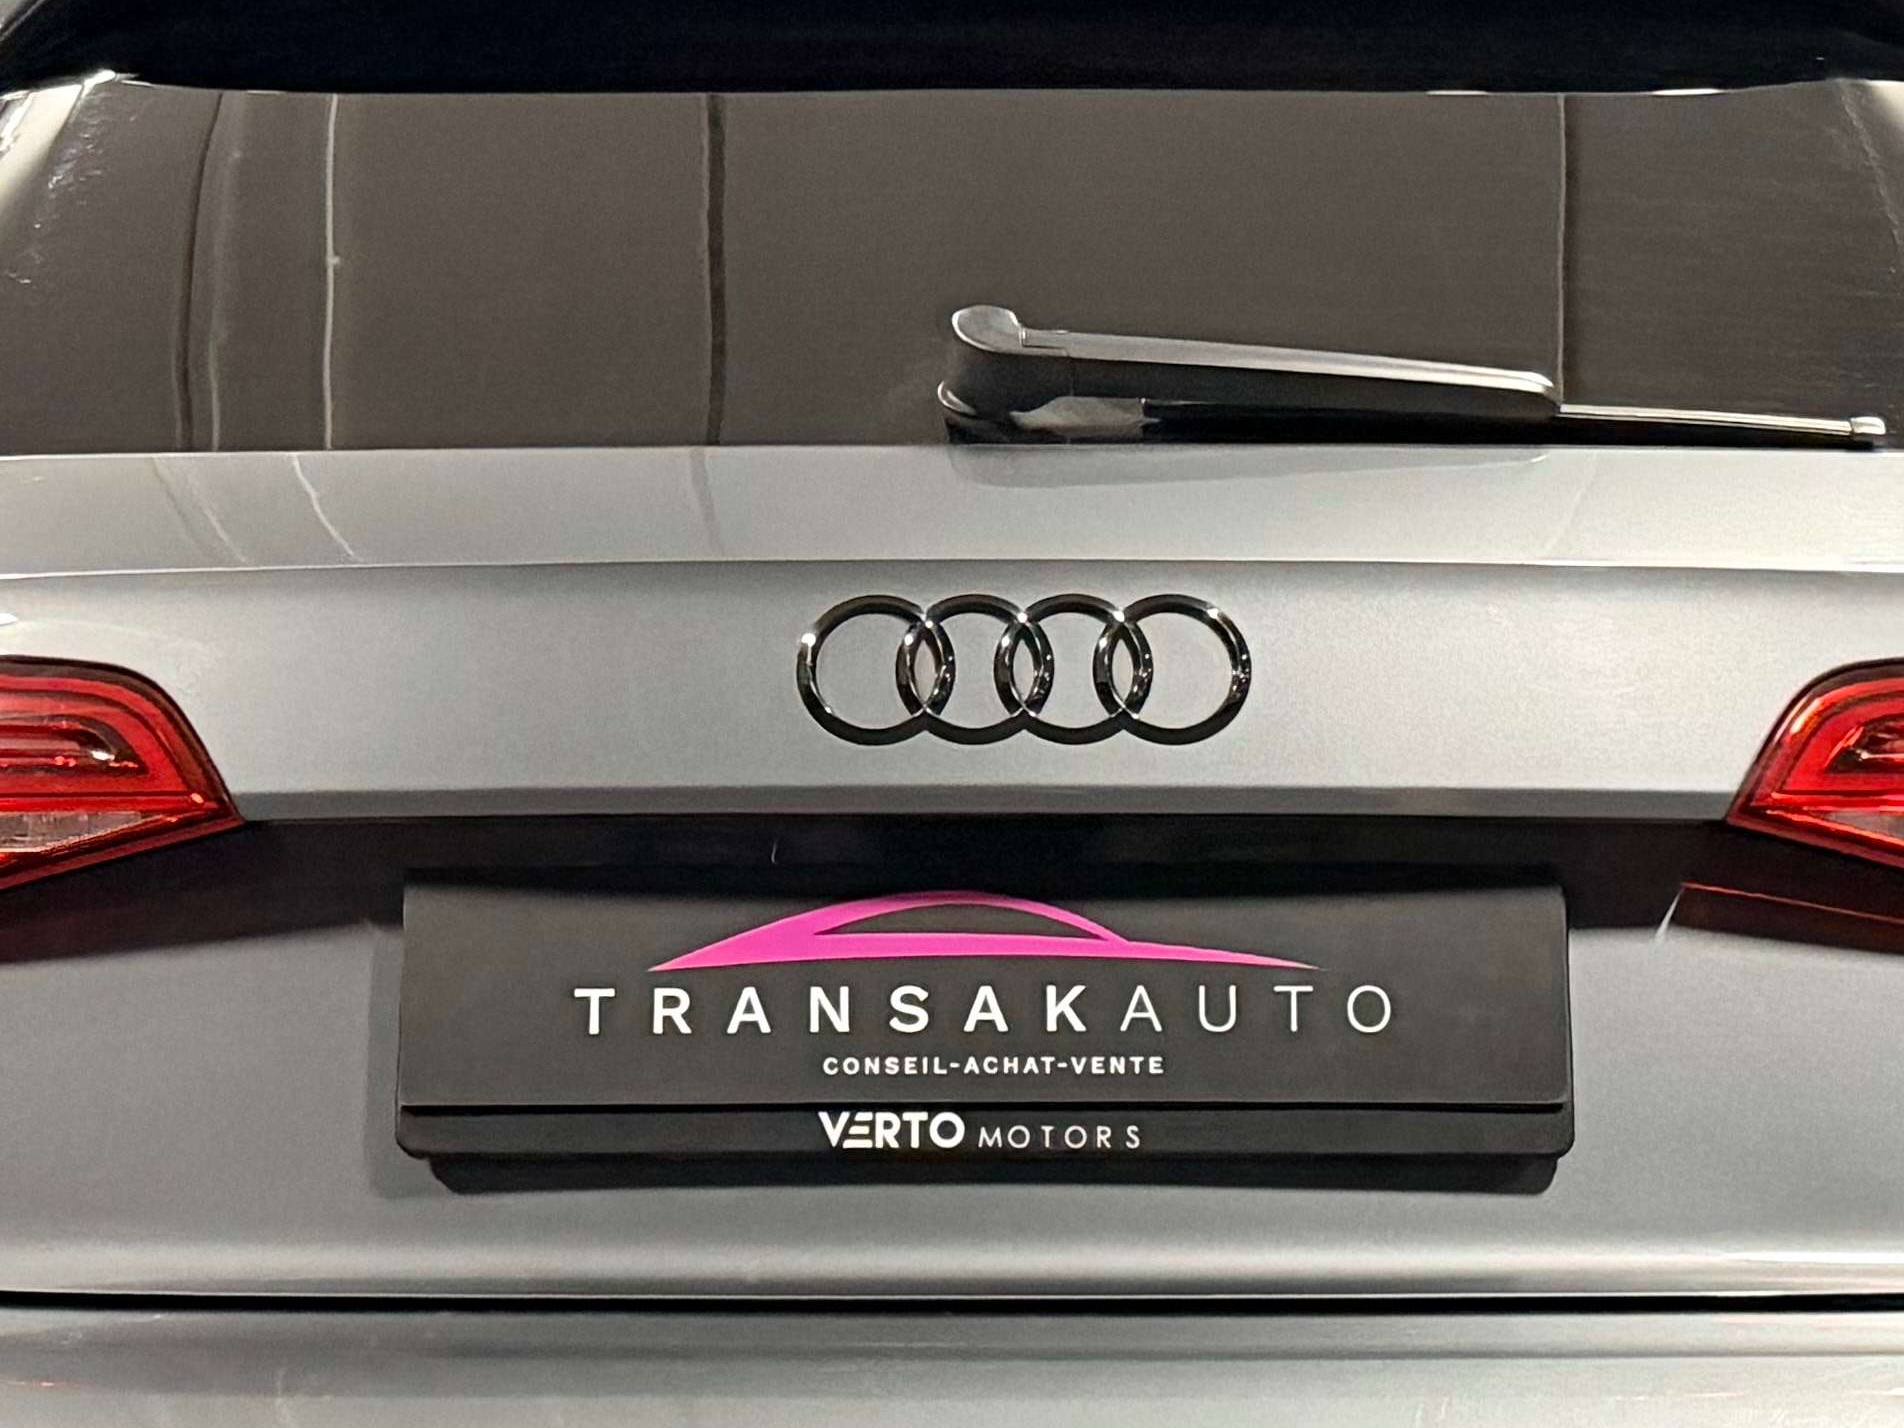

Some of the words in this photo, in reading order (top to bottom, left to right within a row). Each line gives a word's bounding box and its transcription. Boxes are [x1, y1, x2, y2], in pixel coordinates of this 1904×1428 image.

[573, 984, 1392, 1036] TRANSAKAUTO
[822, 1055, 1164, 1076] CONSEIL-ACHAT-VENTE
[817, 1111, 966, 1149] VERTO
[977, 1124, 1141, 1149] MOTORS
